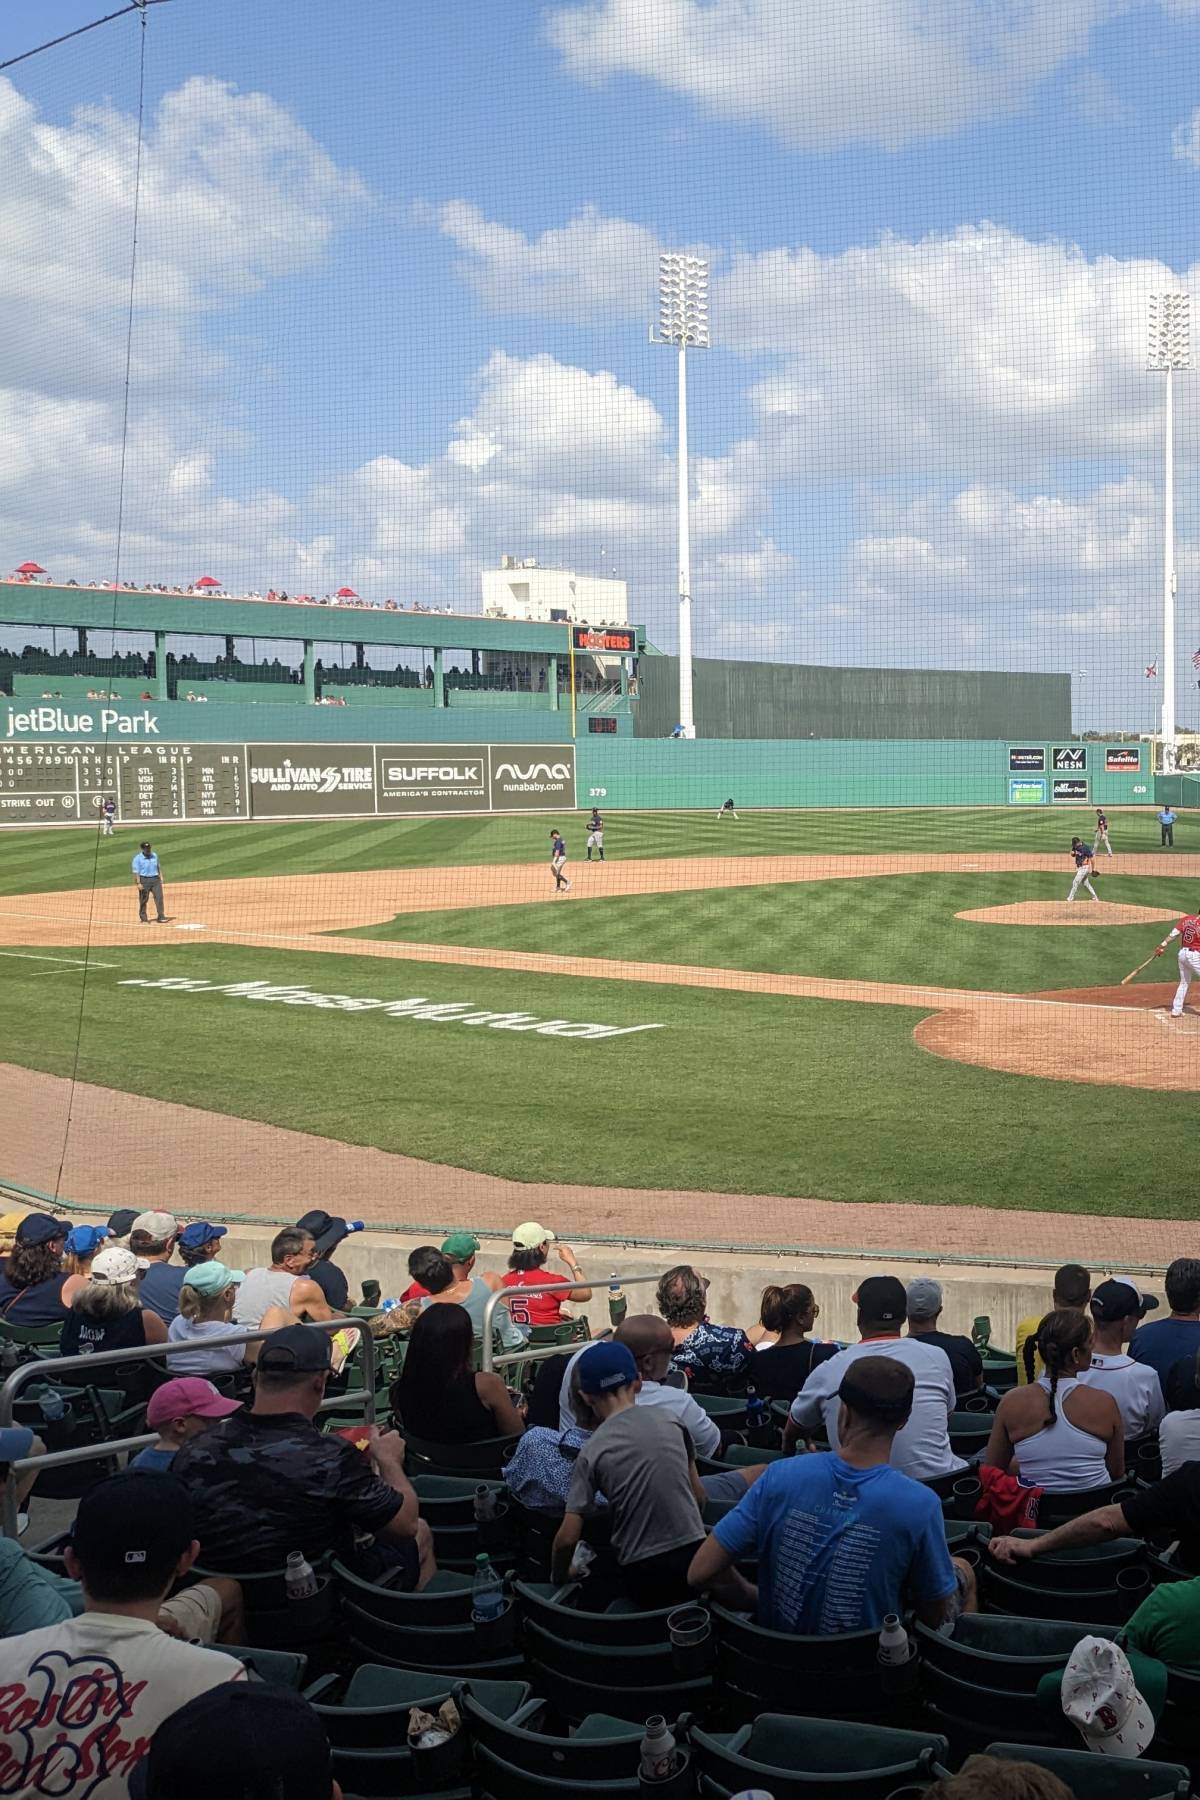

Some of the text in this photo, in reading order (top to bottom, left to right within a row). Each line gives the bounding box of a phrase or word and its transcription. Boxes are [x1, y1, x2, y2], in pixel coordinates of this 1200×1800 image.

[6, 707, 160, 737] jetBlue Park
[118, 746, 192, 755] LEAGUE
[6, 756, 112, 765] 4 5 6 7 8 9 10 R H E
[123, 756, 130, 764] P
[170, 756, 177, 764] R
[187, 756, 193, 764] P
[232, 756, 239, 764] R
[1056, 761, 1083, 769] NESN
[8, 768, 14, 776] 0
[17, 768, 23, 776] 0
[250, 767, 372, 783] SULLIVAN TIRE
[388, 766, 478, 781] SUFFOLK
[494, 763, 571, 779] nuna
[9, 780, 15, 788] 0
[293, 783, 318, 791] AUTO
[338, 782, 373, 790] SERVICE
[503, 782, 564, 793] nunababy.com
[138, 792, 154, 800] DET
[589, 788, 607, 797] 379
[1, 799, 55, 808] STRIKE OUT
[201, 799, 217, 807] NYM
[192, 981, 666, 1040] MassMutual
[510, 1298, 531, 1327] 5
[1094, 1706, 1118, 1731] B
